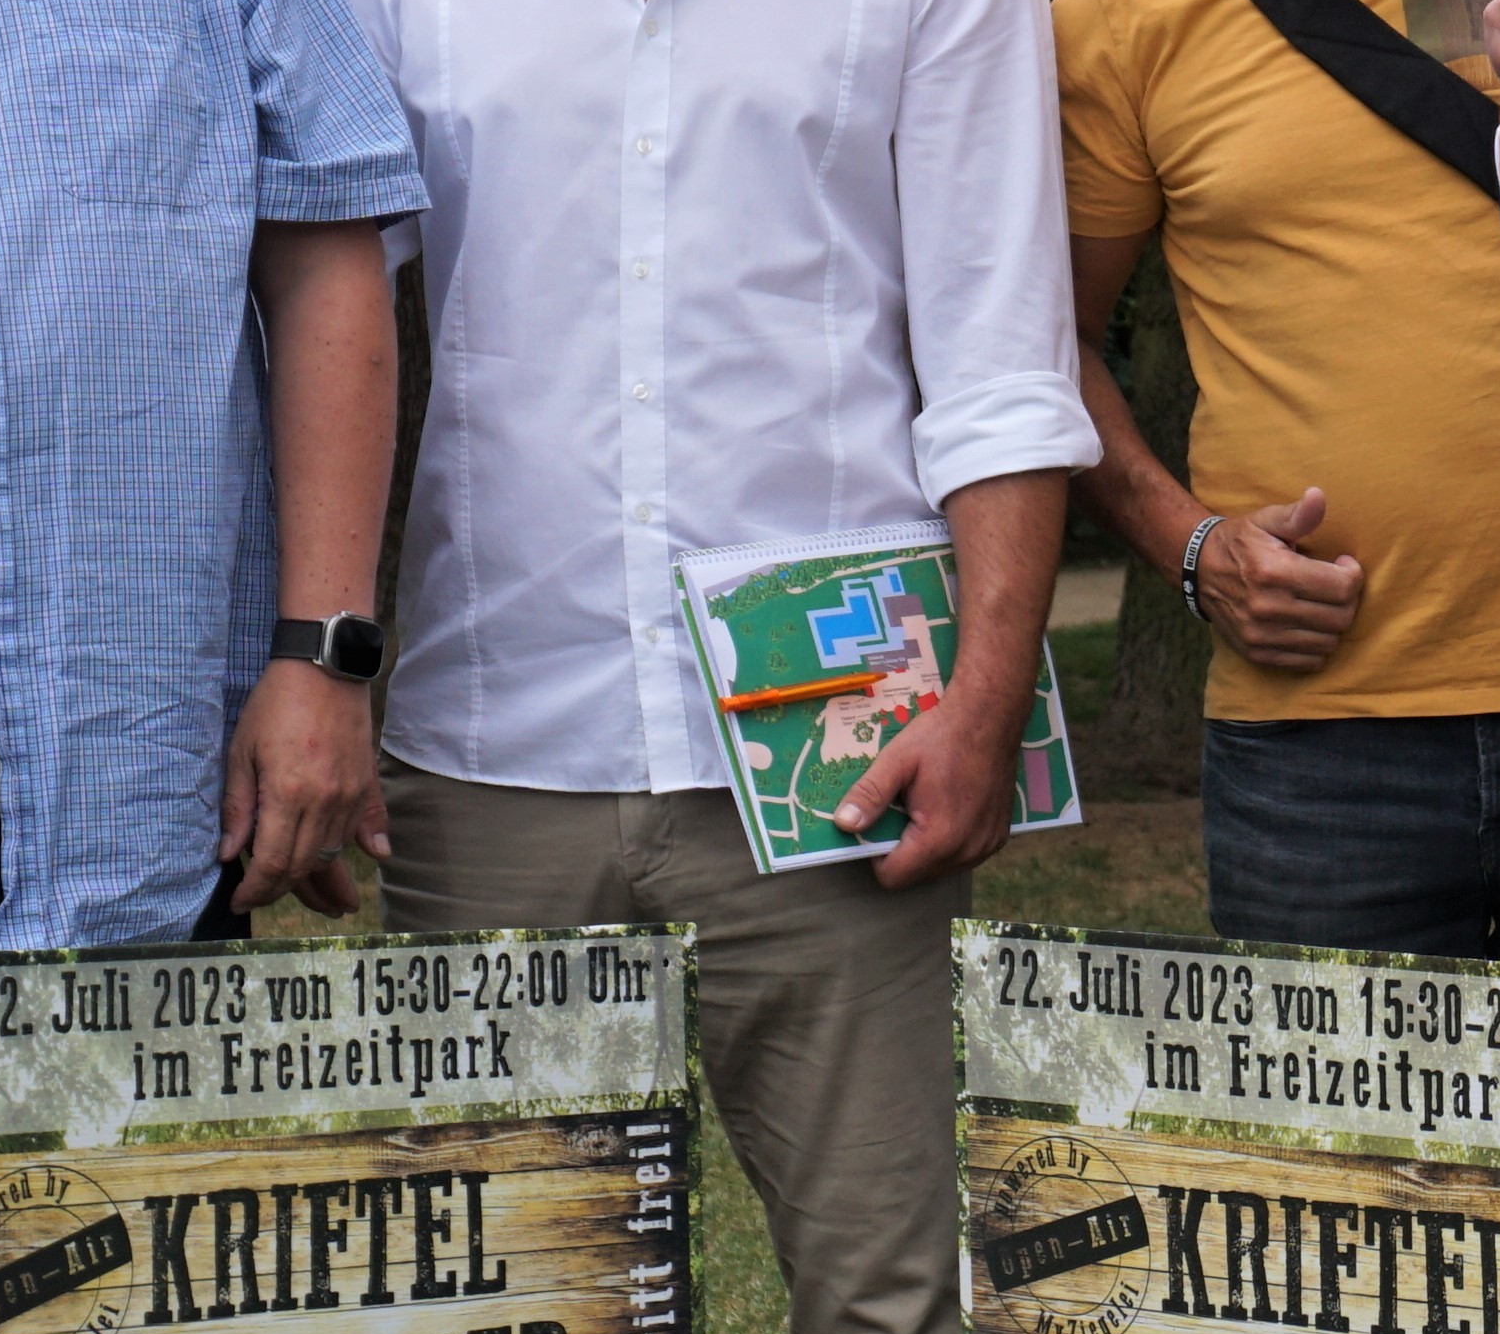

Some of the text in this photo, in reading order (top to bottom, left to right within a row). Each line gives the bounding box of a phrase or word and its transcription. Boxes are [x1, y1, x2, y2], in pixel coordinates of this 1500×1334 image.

[52, 968, 133, 1033] Juli
[153, 964, 247, 1027] 2023
[264, 973, 332, 1022] von
[586, 945, 652, 1004] Uhr
[998, 947, 1052, 1009] 22.
[1070, 949, 1143, 1017] Juli
[1162, 959, 1254, 1026] 2023
[1271, 981, 1339, 1035] von
[133, 1019, 512, 1100] im Freizeitpark
[1145, 1029, 1201, 1093] im
[144, 1169, 506, 1325] KRIFTEL
